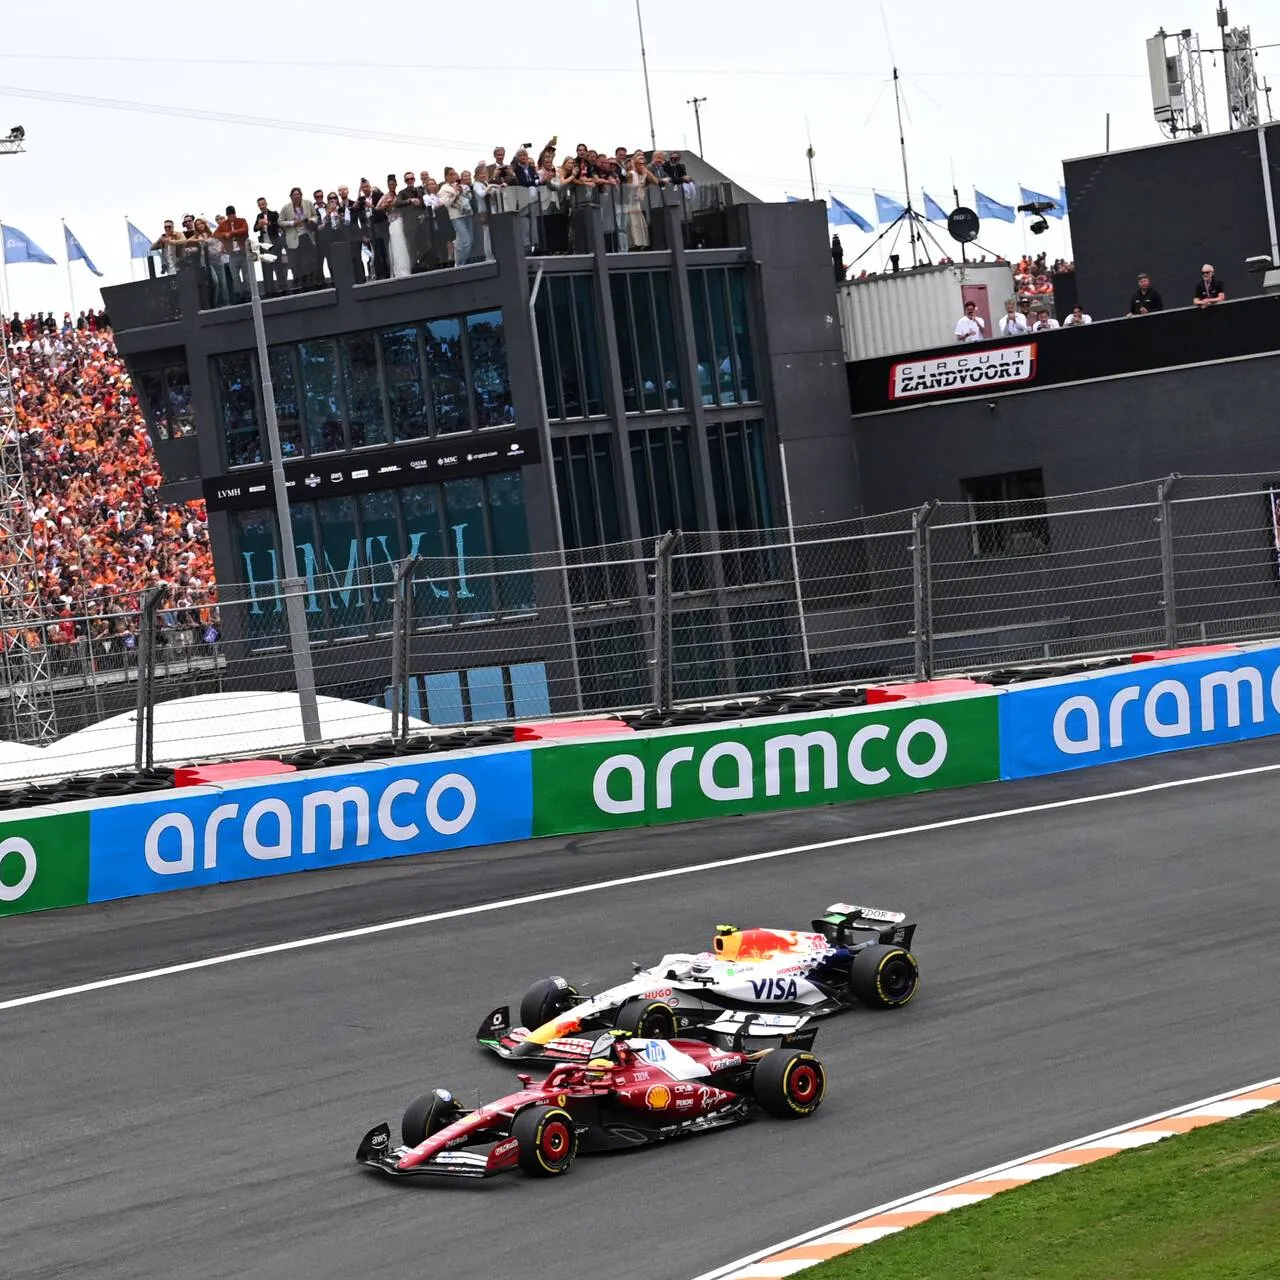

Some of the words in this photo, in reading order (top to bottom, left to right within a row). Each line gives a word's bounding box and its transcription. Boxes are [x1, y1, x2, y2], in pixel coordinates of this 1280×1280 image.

[902, 351, 1023, 375] CIRCUIT
[901, 360, 1024, 393] ZANDVOORT
[218, 488, 241, 499] LVMH
[593, 717, 947, 815] aramco
[145, 772, 477, 876] aramco
[644, 988, 672, 1000] HUGO
[745, 978, 797, 1000] VISA
[646, 1041, 667, 1062] hp
[633, 1071, 650, 1081] IBM
[372, 1132, 387, 1145] aws
